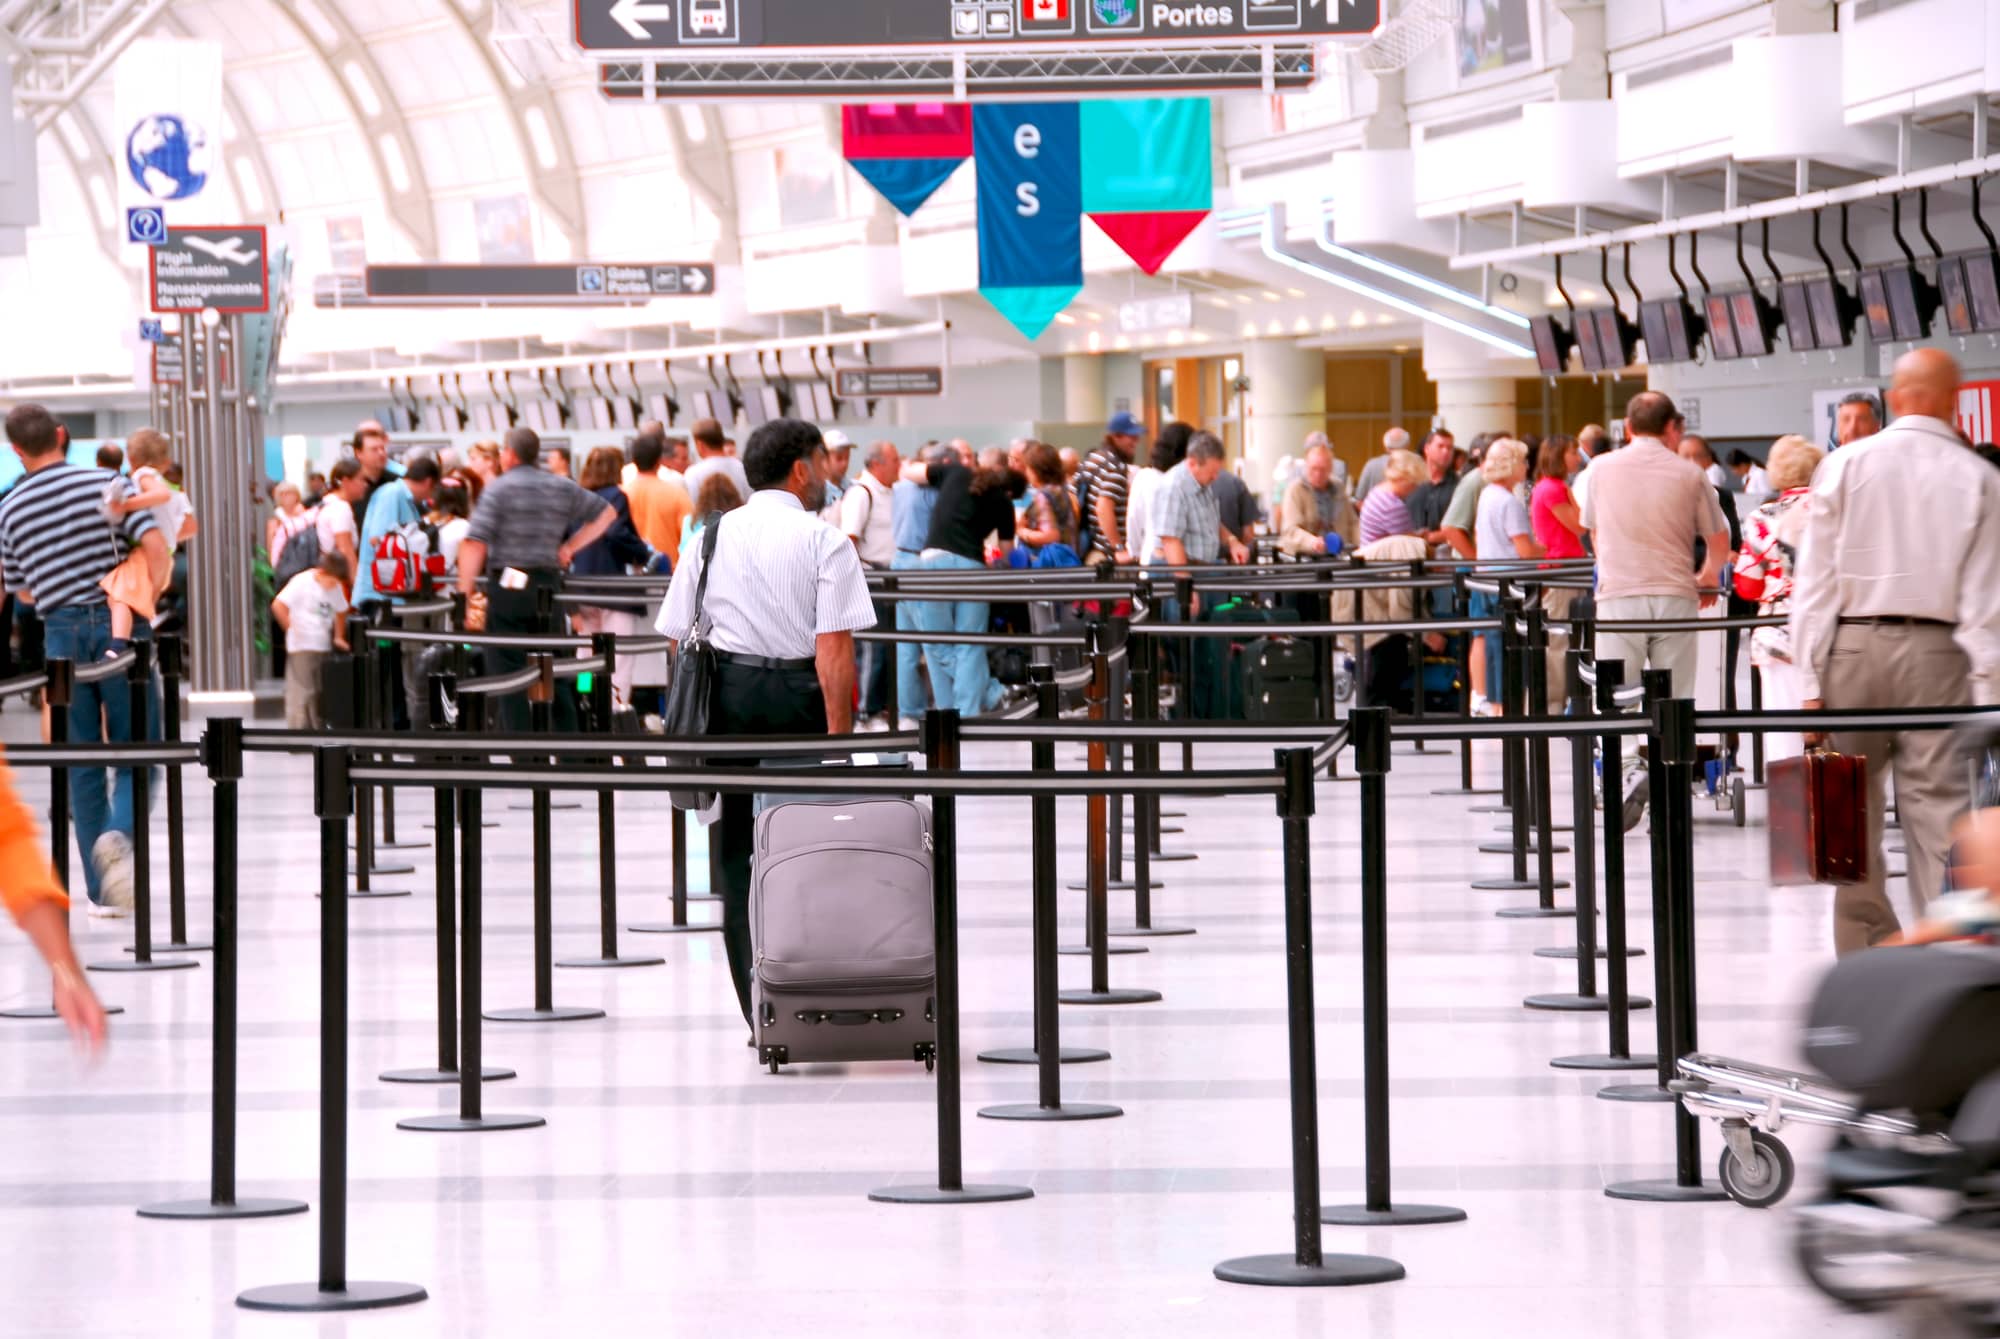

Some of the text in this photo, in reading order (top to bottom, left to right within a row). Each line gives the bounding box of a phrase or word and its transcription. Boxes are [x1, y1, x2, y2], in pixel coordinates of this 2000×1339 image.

[1152, 3, 1234, 28] Portes
[156, 251, 193, 267] Flight
[156, 264, 230, 278] Information
[157, 282, 263, 298] Renseignements
[607, 280, 651, 294] Portes
[157, 296, 175, 308] de
